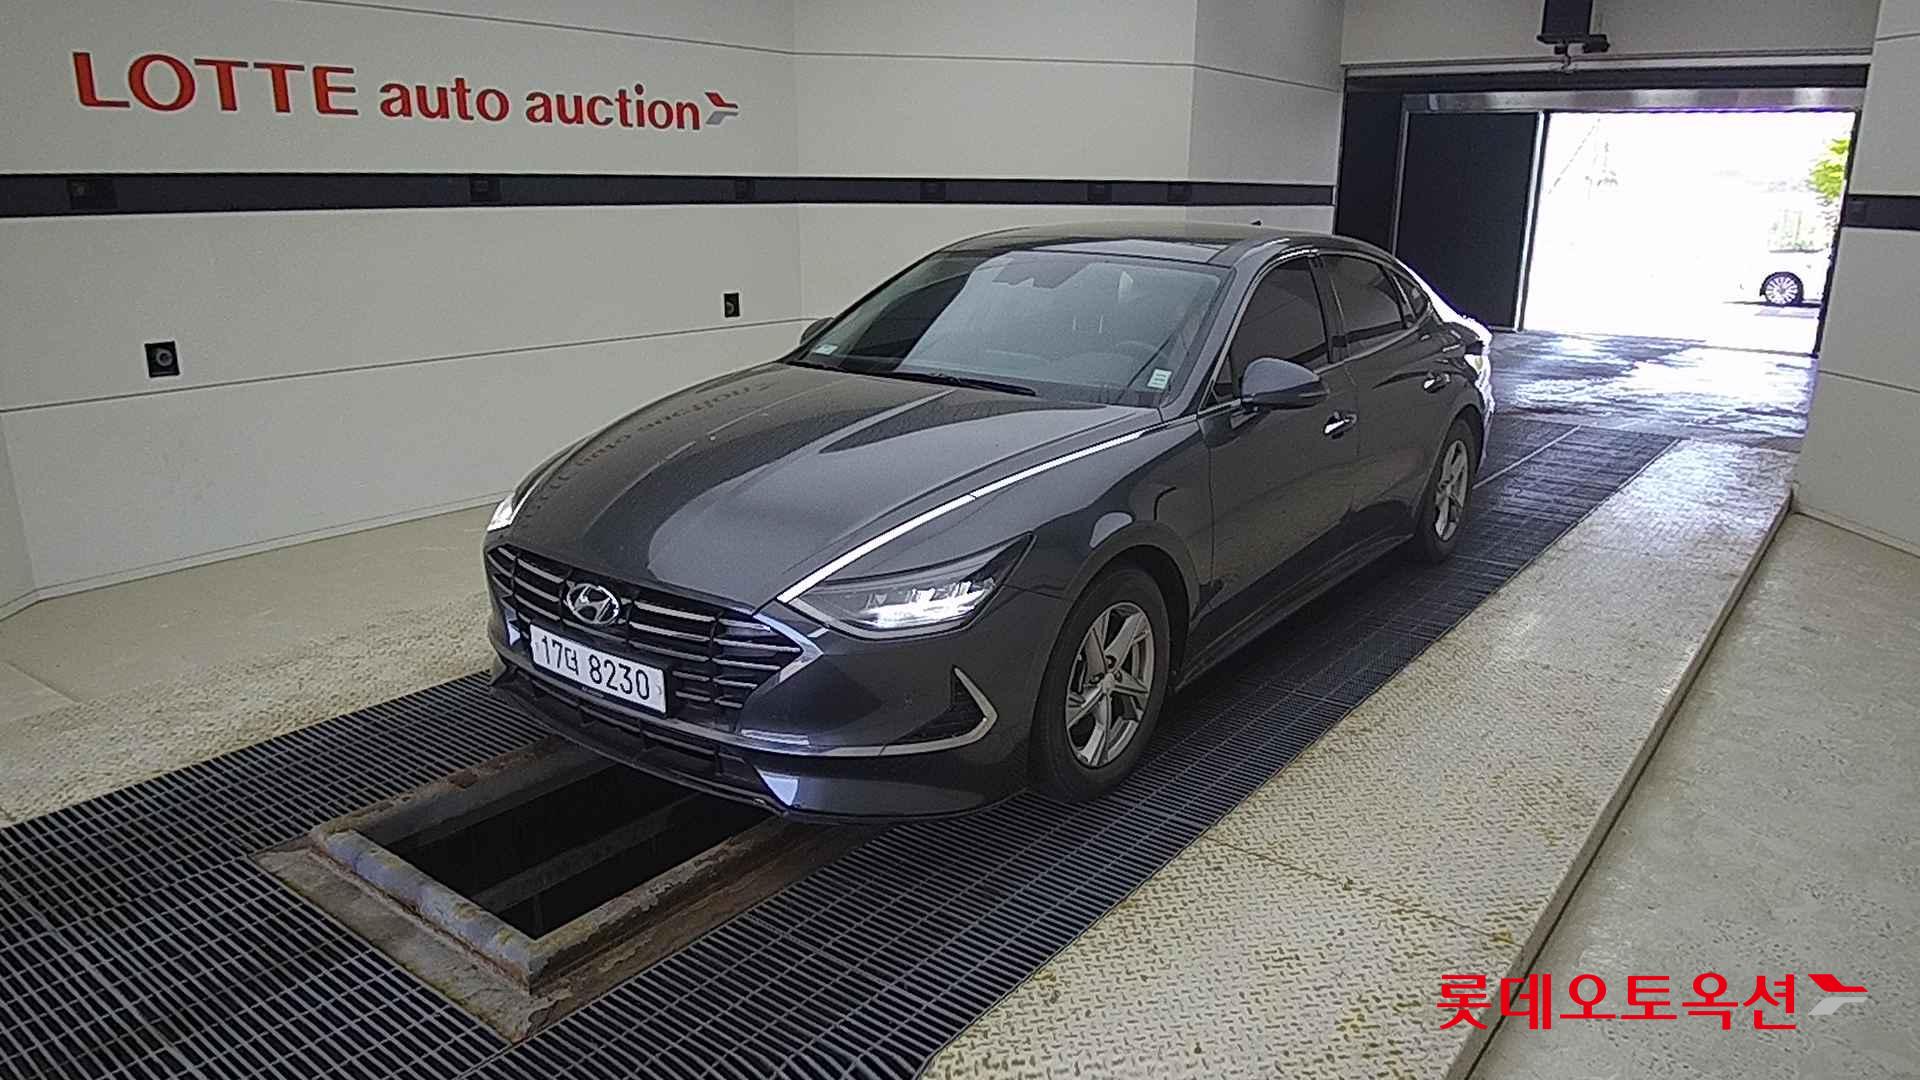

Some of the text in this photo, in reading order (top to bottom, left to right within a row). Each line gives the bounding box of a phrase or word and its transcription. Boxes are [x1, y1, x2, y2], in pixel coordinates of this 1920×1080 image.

[73, 51, 701, 130] LOTTE auto auction
[588, 654, 650, 701] 8230
